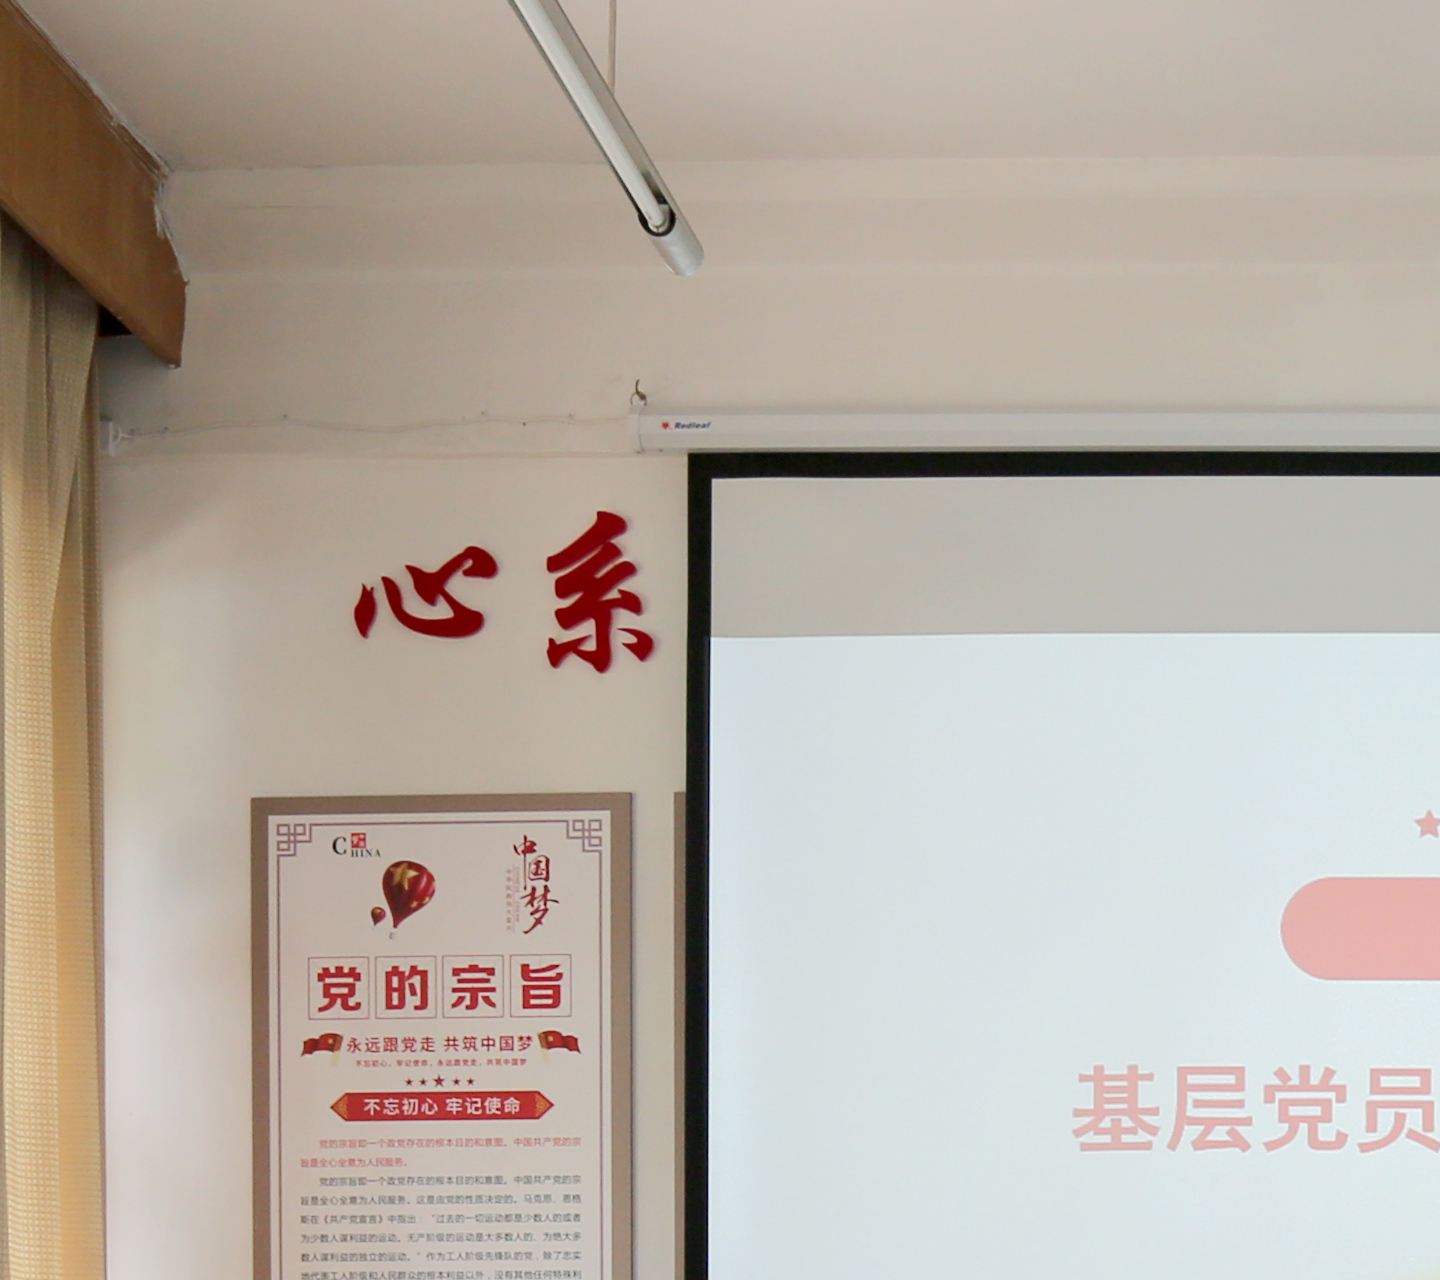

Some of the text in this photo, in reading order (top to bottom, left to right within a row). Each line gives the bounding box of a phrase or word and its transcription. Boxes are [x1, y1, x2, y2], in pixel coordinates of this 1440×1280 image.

[354, 510, 655, 673] 心系
[513, 834, 560, 934] 中国梦
[317, 963, 564, 1013] 党的宗旨
[346, 1035, 534, 1053] 永远跟党走 共筑中国梦
[363, 1097, 521, 1115] 不忘初心 牢记使命
